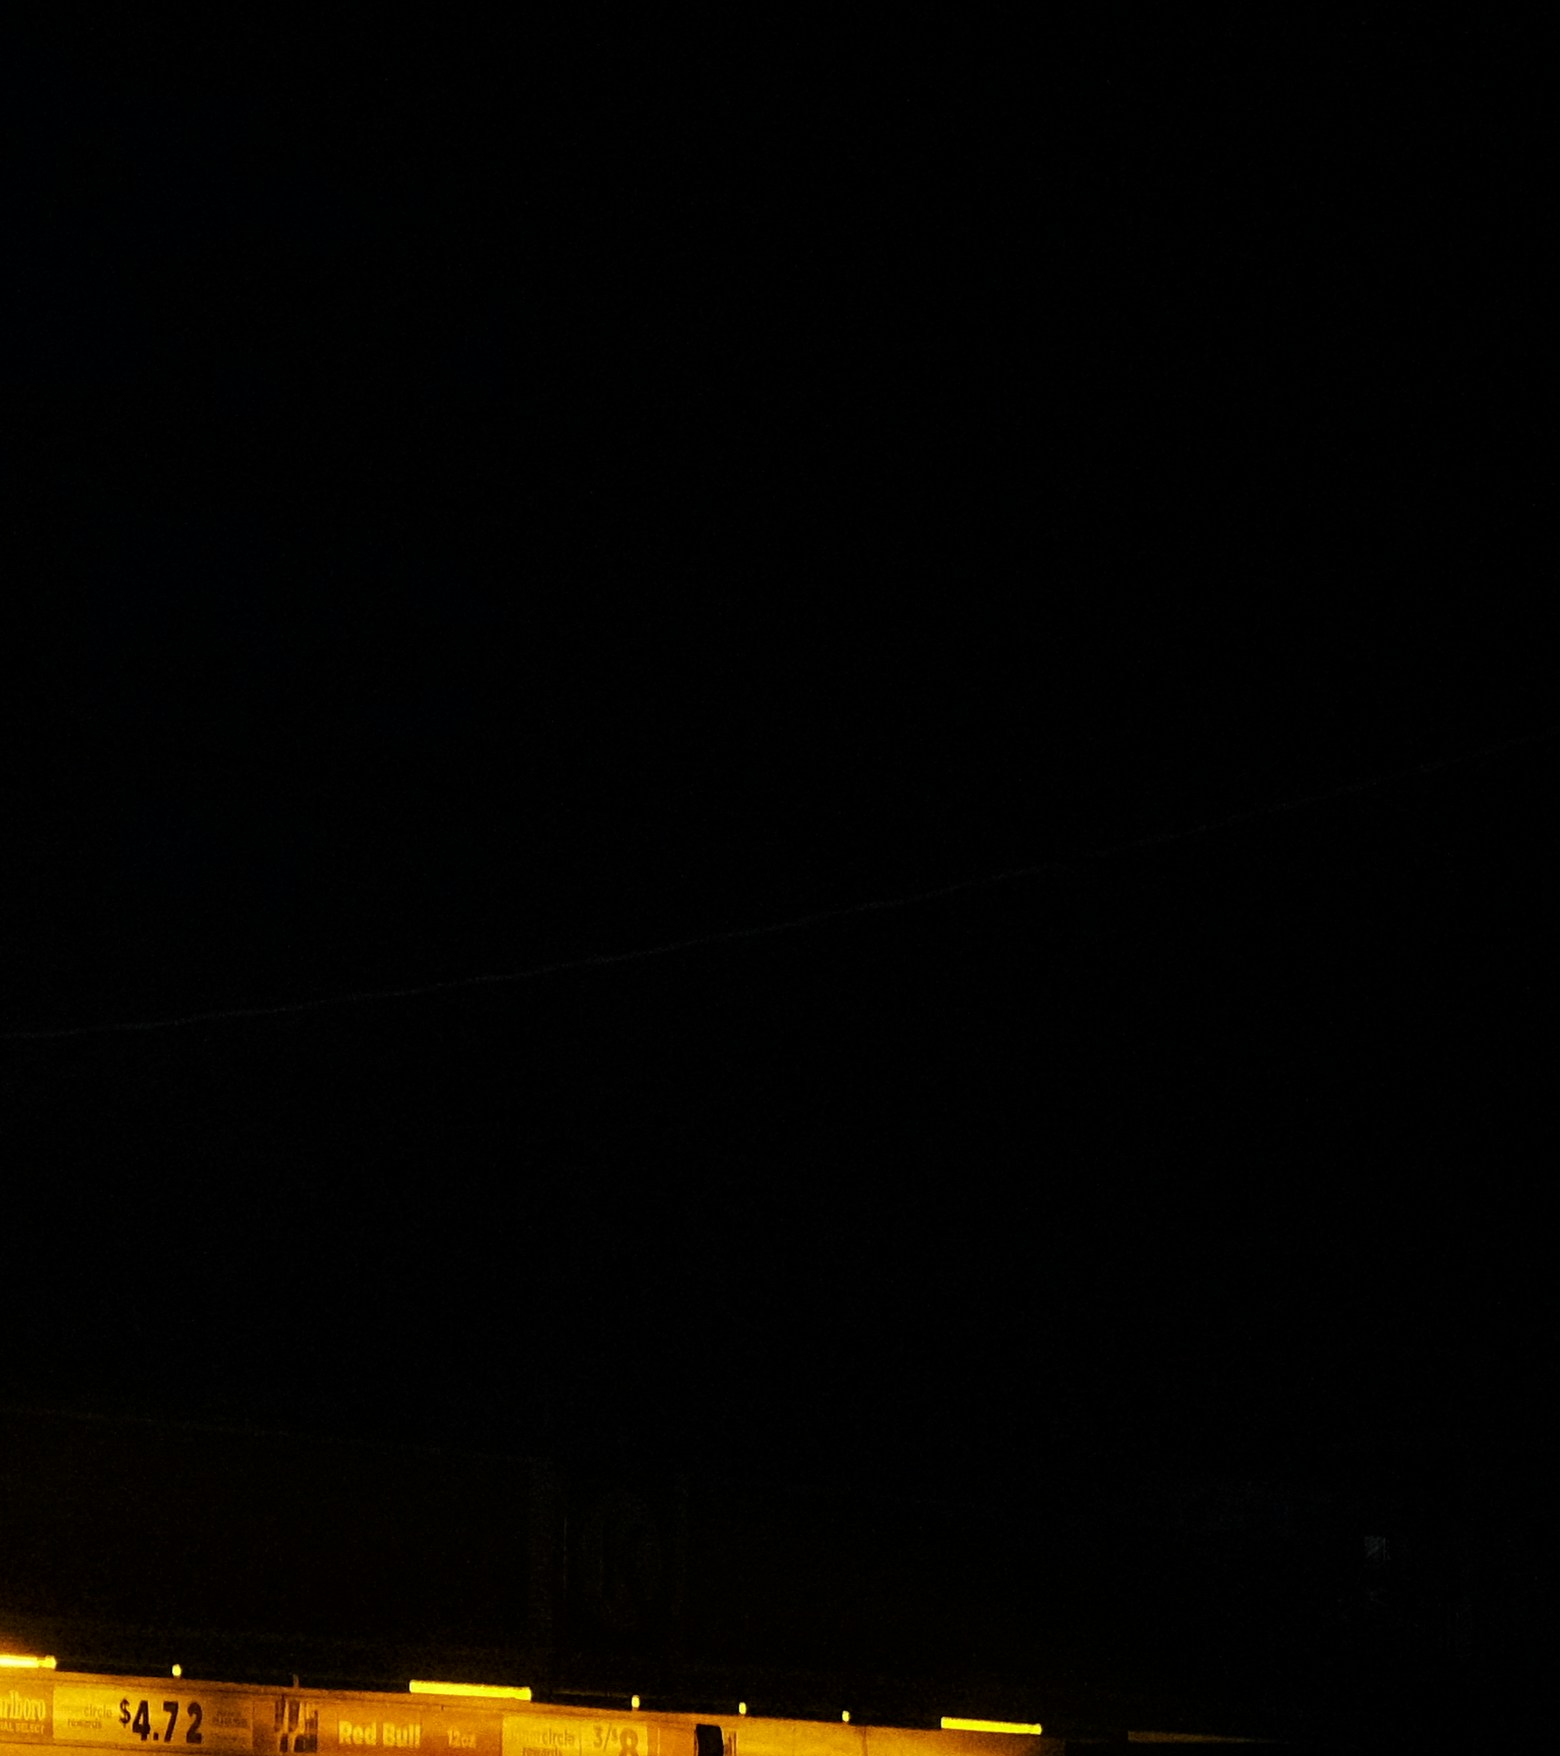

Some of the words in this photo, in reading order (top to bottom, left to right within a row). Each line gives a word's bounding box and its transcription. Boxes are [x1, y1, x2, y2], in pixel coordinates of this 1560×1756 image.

[84, 1703, 113, 1719] circle
[15, 1722, 45, 1734] SELECT
[120, 1698, 204, 1745] $4.72
[338, 1720, 377, 1747] Red
[382, 1722, 421, 1748] Bull
[542, 1728, 575, 1746] circle
